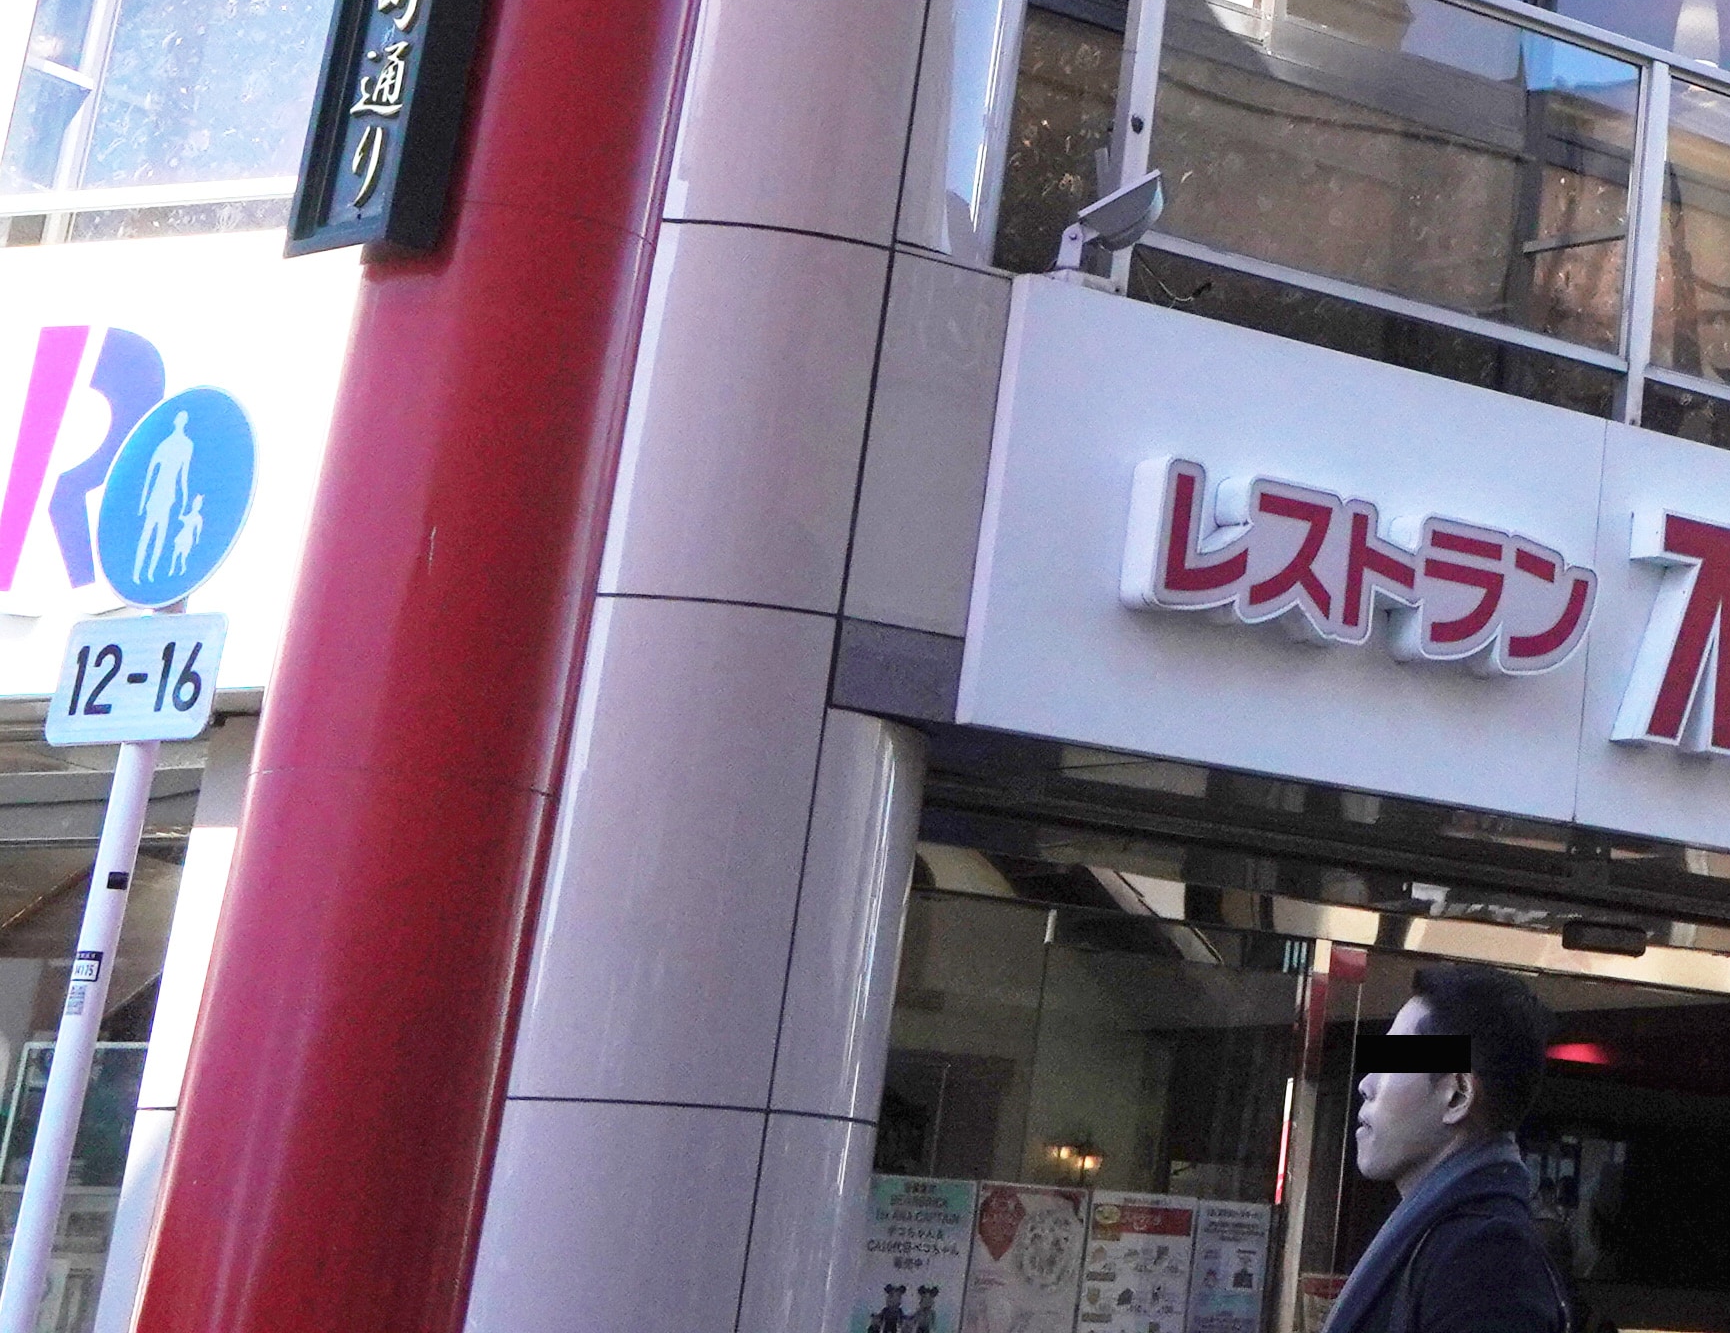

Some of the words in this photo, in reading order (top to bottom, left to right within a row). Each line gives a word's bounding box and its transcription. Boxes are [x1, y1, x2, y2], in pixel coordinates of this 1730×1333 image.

[1165, 469, 1594, 669] レストラン
[66, 639, 203, 717] 12-16
